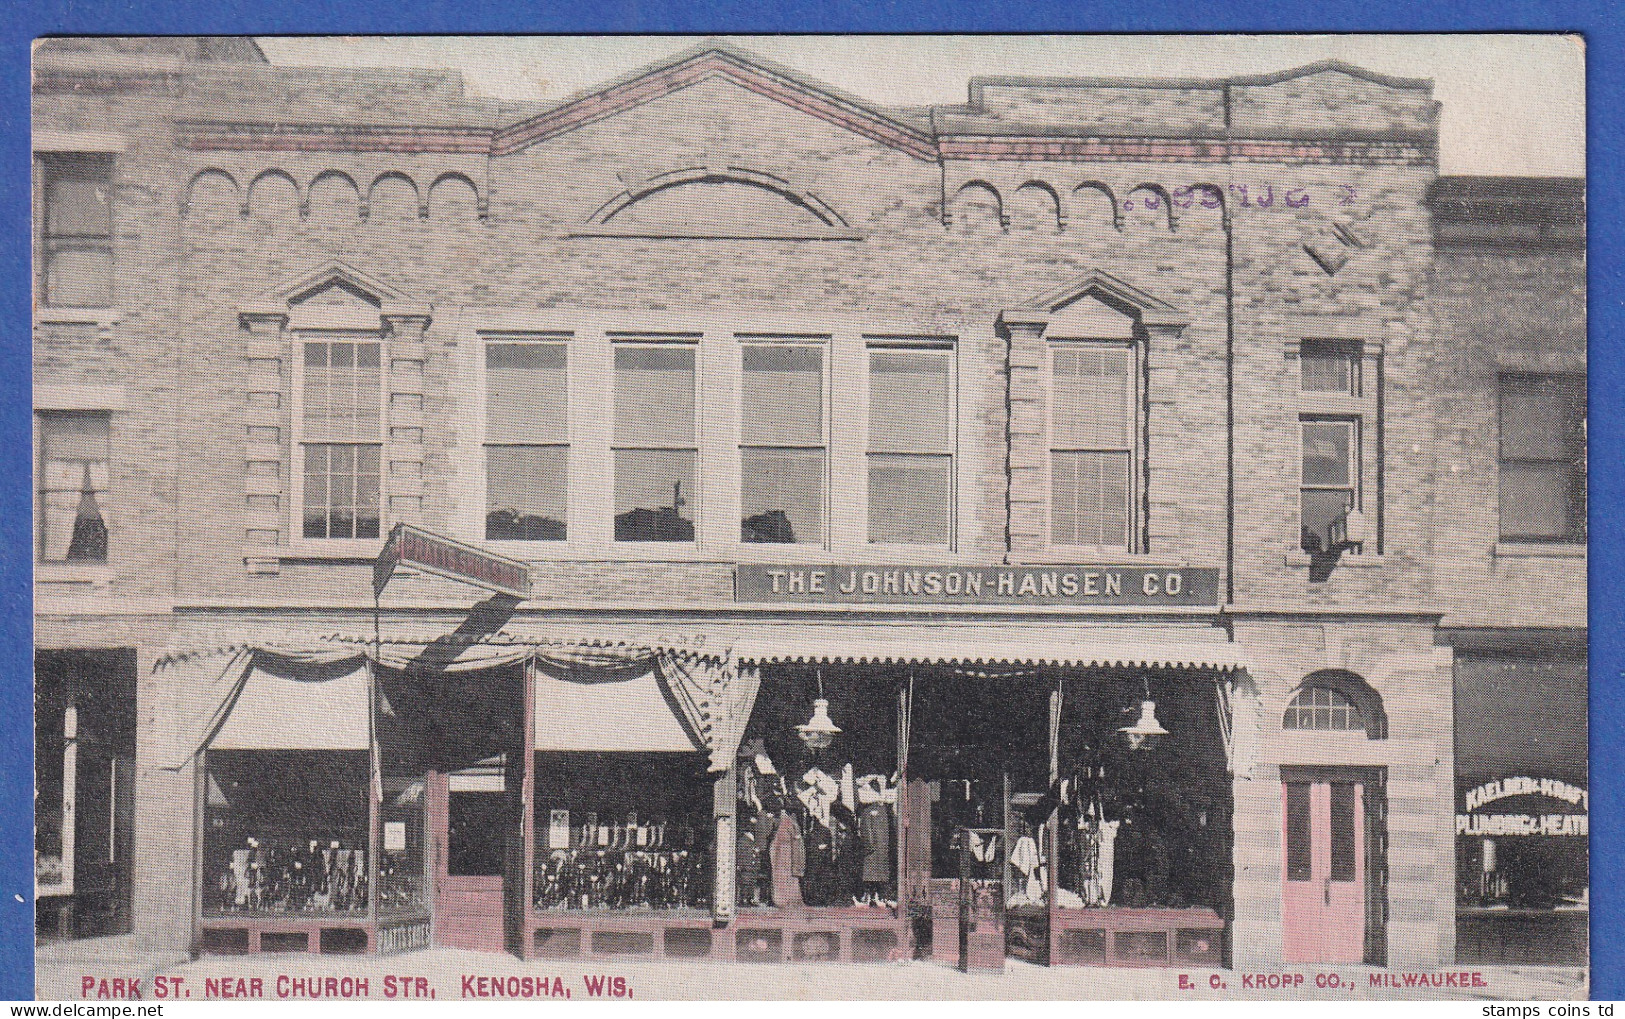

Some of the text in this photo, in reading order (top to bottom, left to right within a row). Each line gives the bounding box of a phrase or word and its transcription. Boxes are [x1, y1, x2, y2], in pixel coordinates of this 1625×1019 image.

[767, 568, 1195, 597] THE JOHNSON-HANSEN CO.
